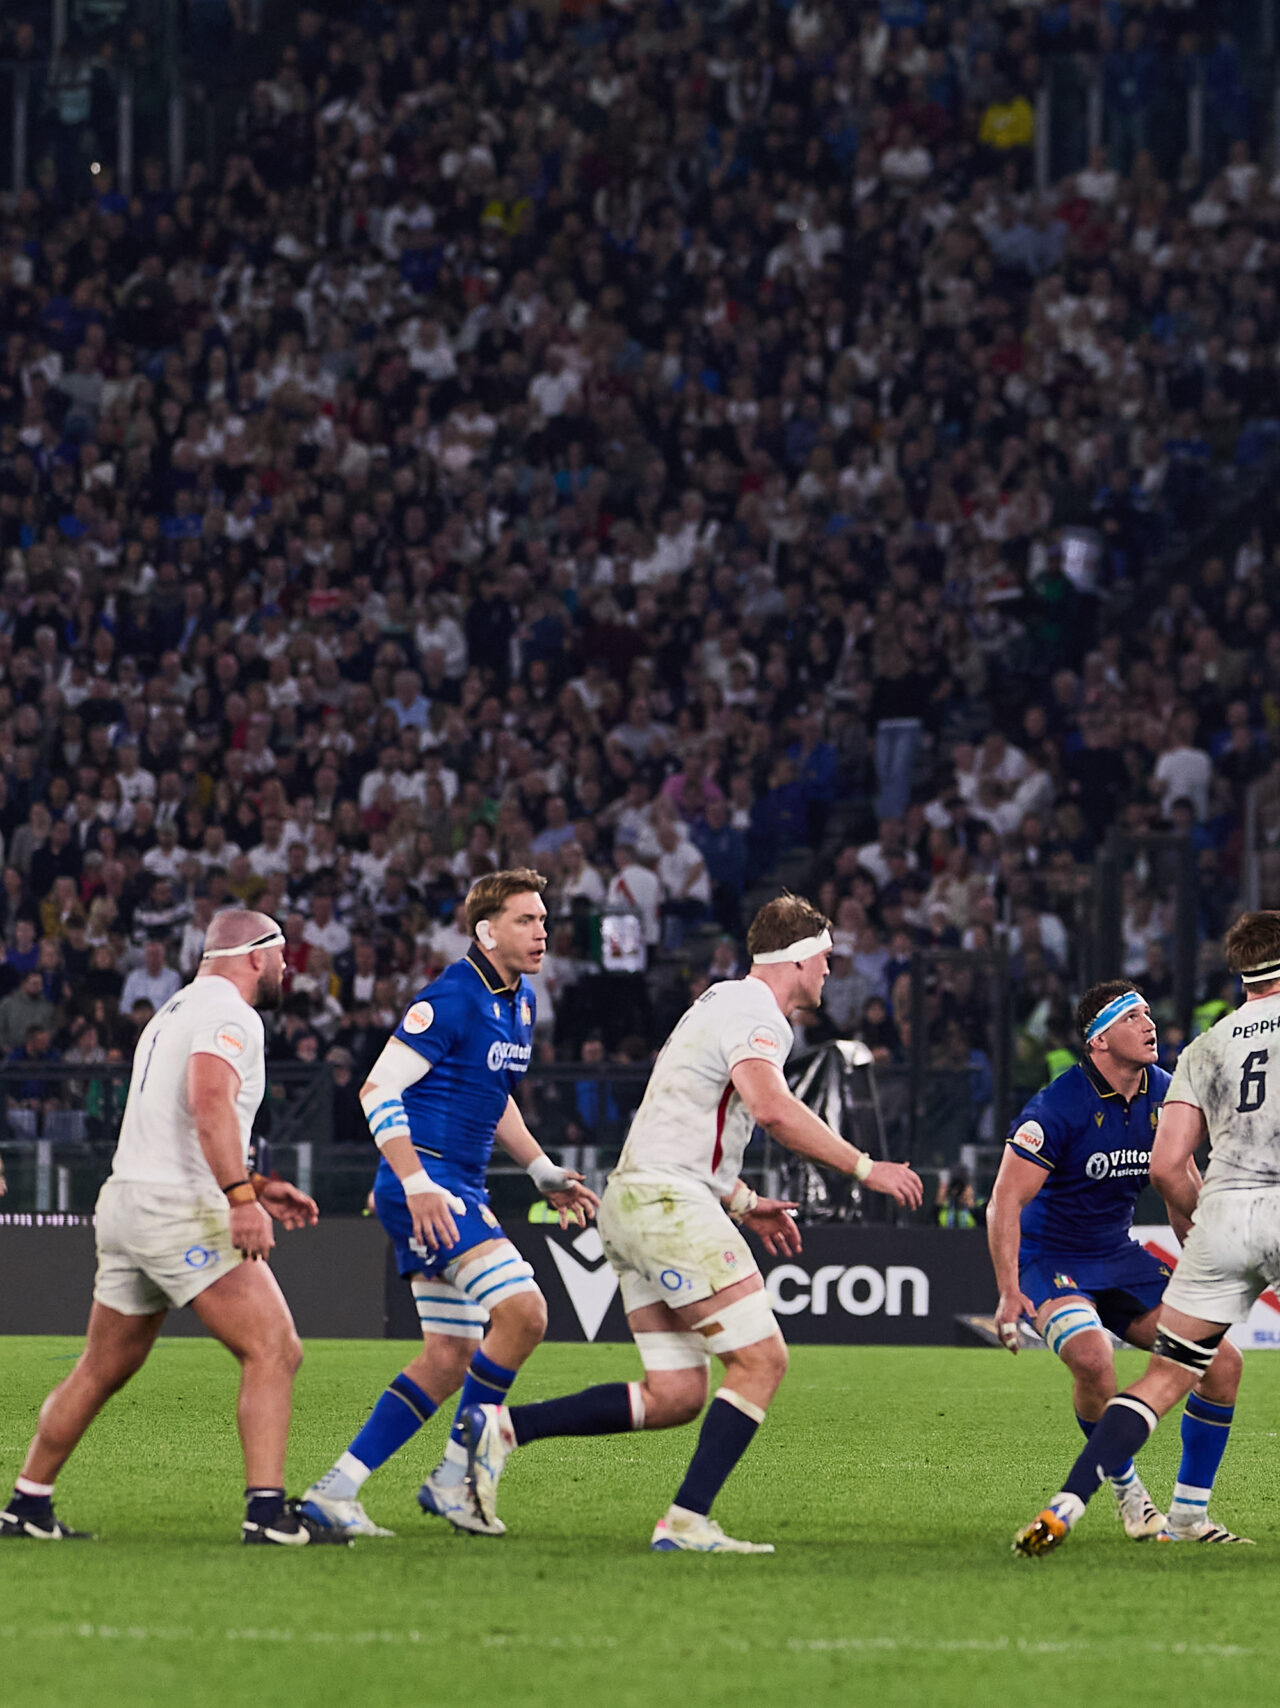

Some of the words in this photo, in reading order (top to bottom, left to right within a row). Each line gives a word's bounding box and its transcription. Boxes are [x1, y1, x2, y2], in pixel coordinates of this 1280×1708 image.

[1235, 1048, 1270, 1114] 6
[1109, 1149, 1152, 1167] Vittor
[765, 1264, 930, 1317] cron
